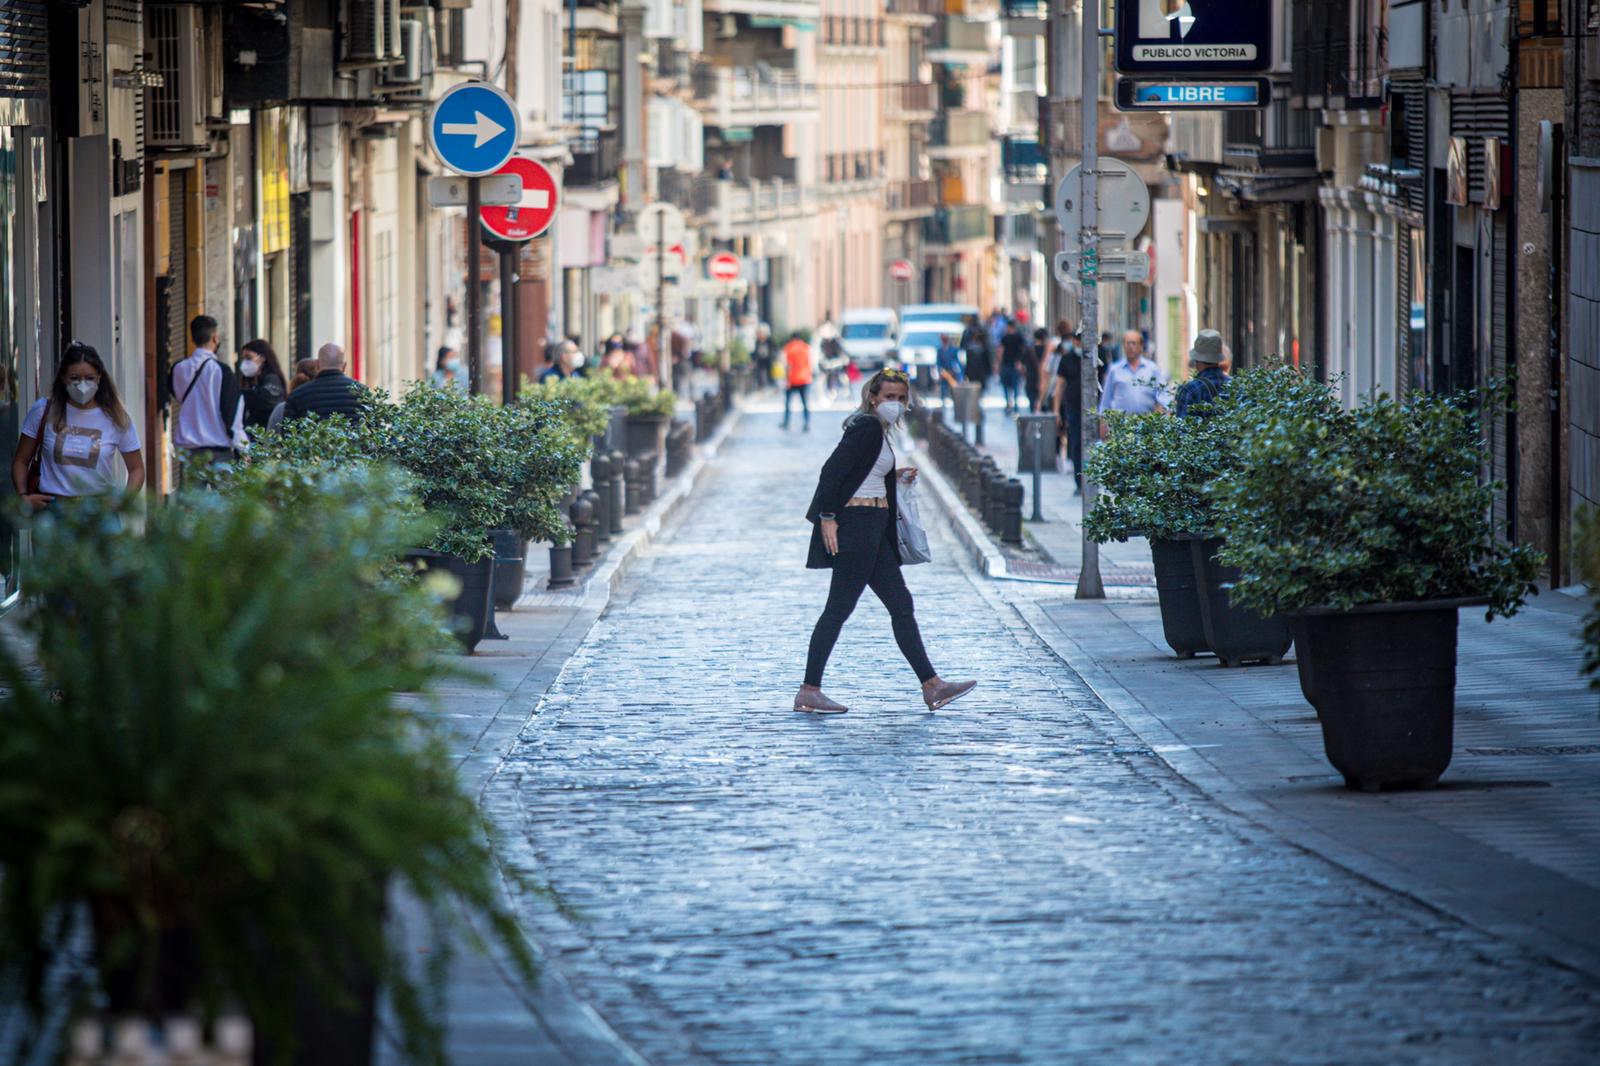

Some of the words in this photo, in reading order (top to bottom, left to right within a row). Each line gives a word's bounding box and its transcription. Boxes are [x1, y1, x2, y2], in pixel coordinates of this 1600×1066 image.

[1142, 48, 1191, 58] PUBLICO
[1195, 48, 1247, 57] VICTORIA
[1167, 87, 1226, 101] LIBRE
